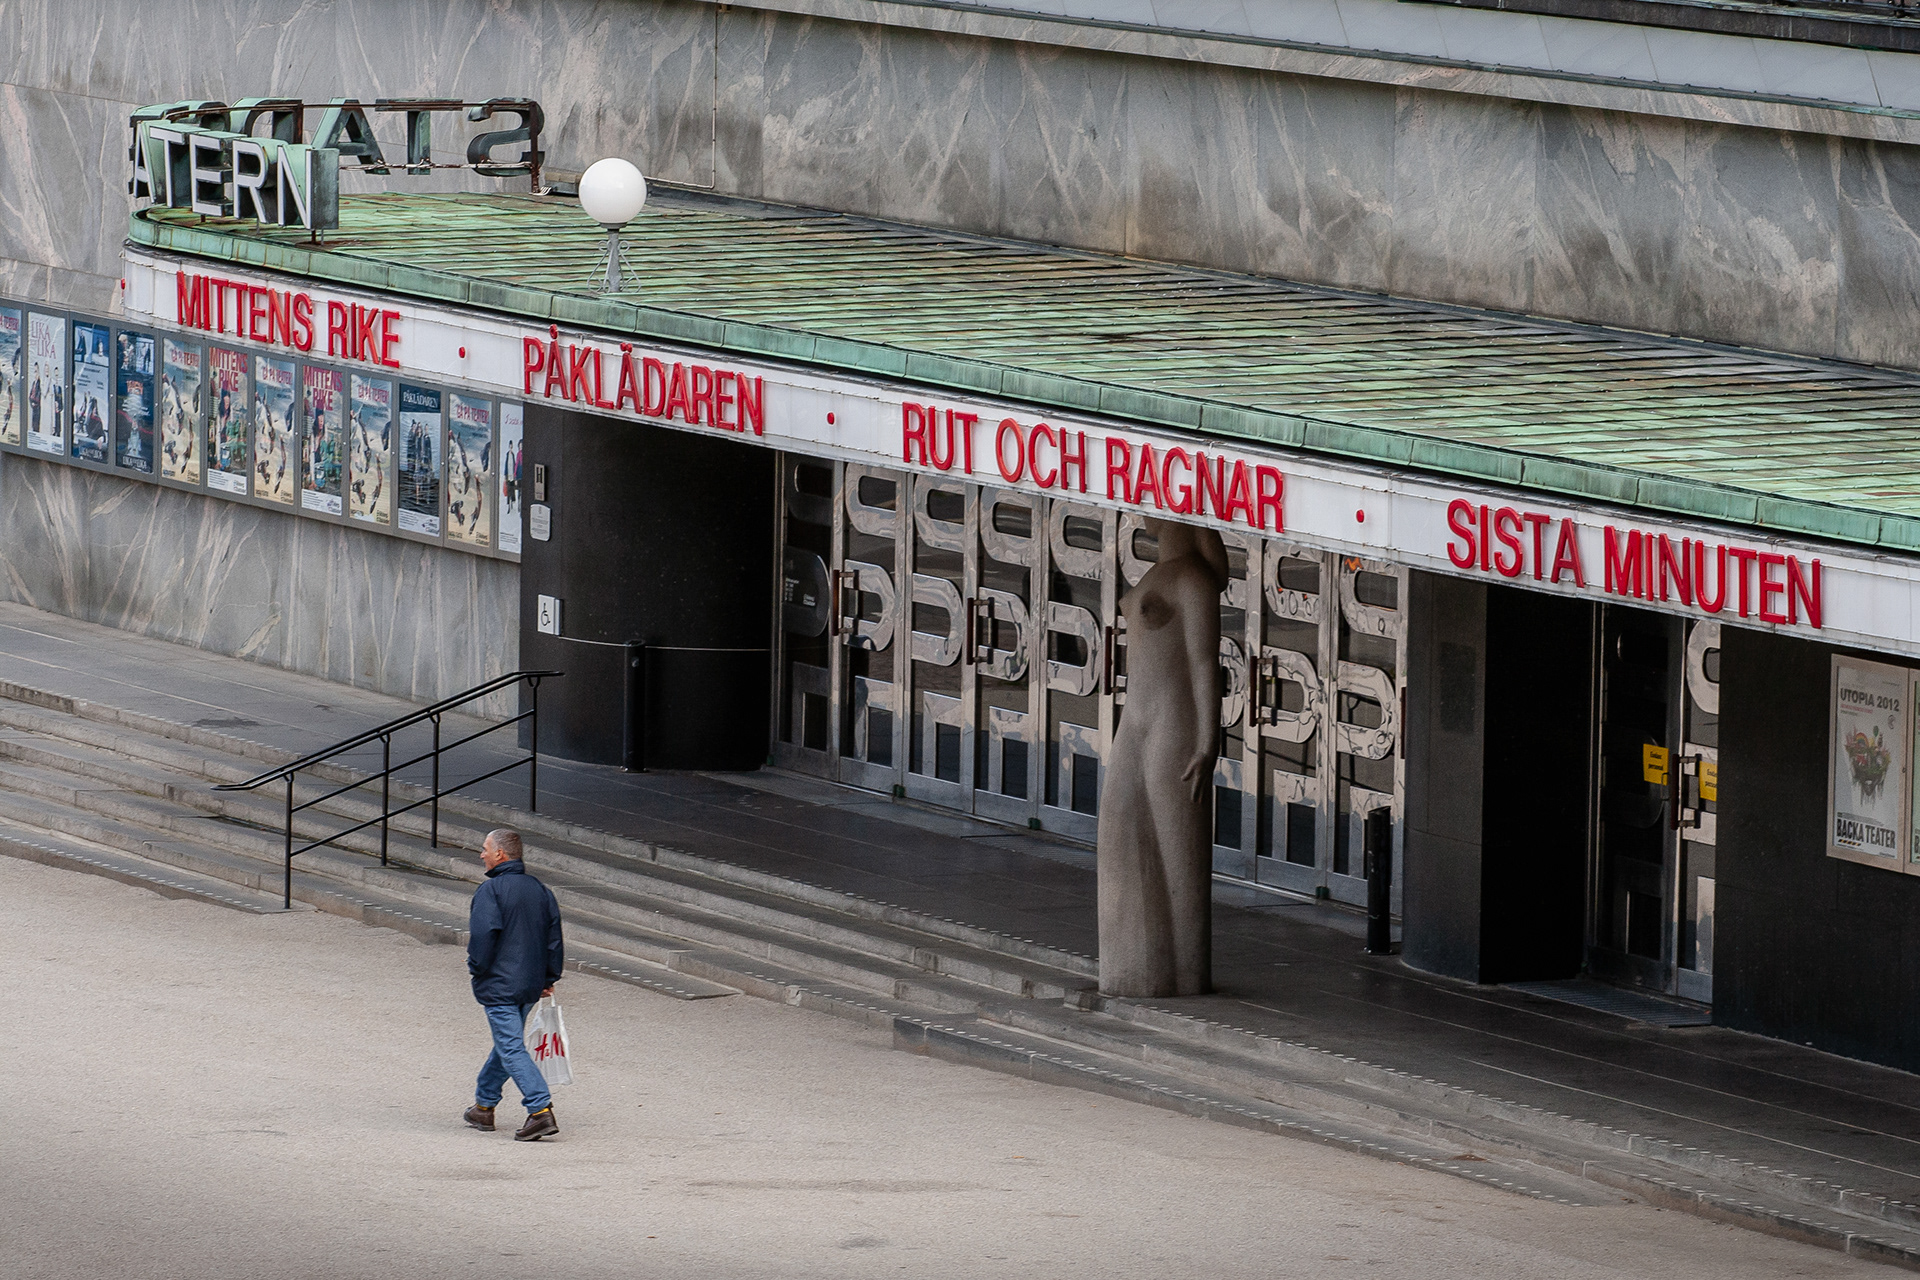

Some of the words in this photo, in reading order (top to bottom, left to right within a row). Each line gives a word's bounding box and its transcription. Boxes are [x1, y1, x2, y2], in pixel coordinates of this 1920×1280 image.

[133, 120, 315, 229] ATERN
[31, 320, 51, 340] LIKA
[176, 270, 314, 352] MITTENS
[327, 300, 401, 368] RIKE
[37, 339, 57, 360] LIKA
[209, 347, 248, 374] MITTENS
[219, 369, 239, 393] RIKE
[303, 365, 343, 393] MITTENS
[523, 324, 763, 436] PÅKLÄDAREN
[313, 387, 334, 412] RIKE
[403, 390, 438, 408] PÅKLÄDAREN
[902, 401, 978, 475] RUT
[995, 417, 1087, 494] OCH
[1105, 436, 1285, 534] RAGNAR
[1447, 498, 1585, 588] SISTA
[1604, 525, 1822, 629] MINUTEN
[1840, 688, 1875, 707] UTOPIA
[1877, 696, 1900, 712] 2012
[1836, 818, 1865, 842] BACKA
[1865, 825, 1896, 849] TEATER
[534, 1032, 565, 1062] H&M
